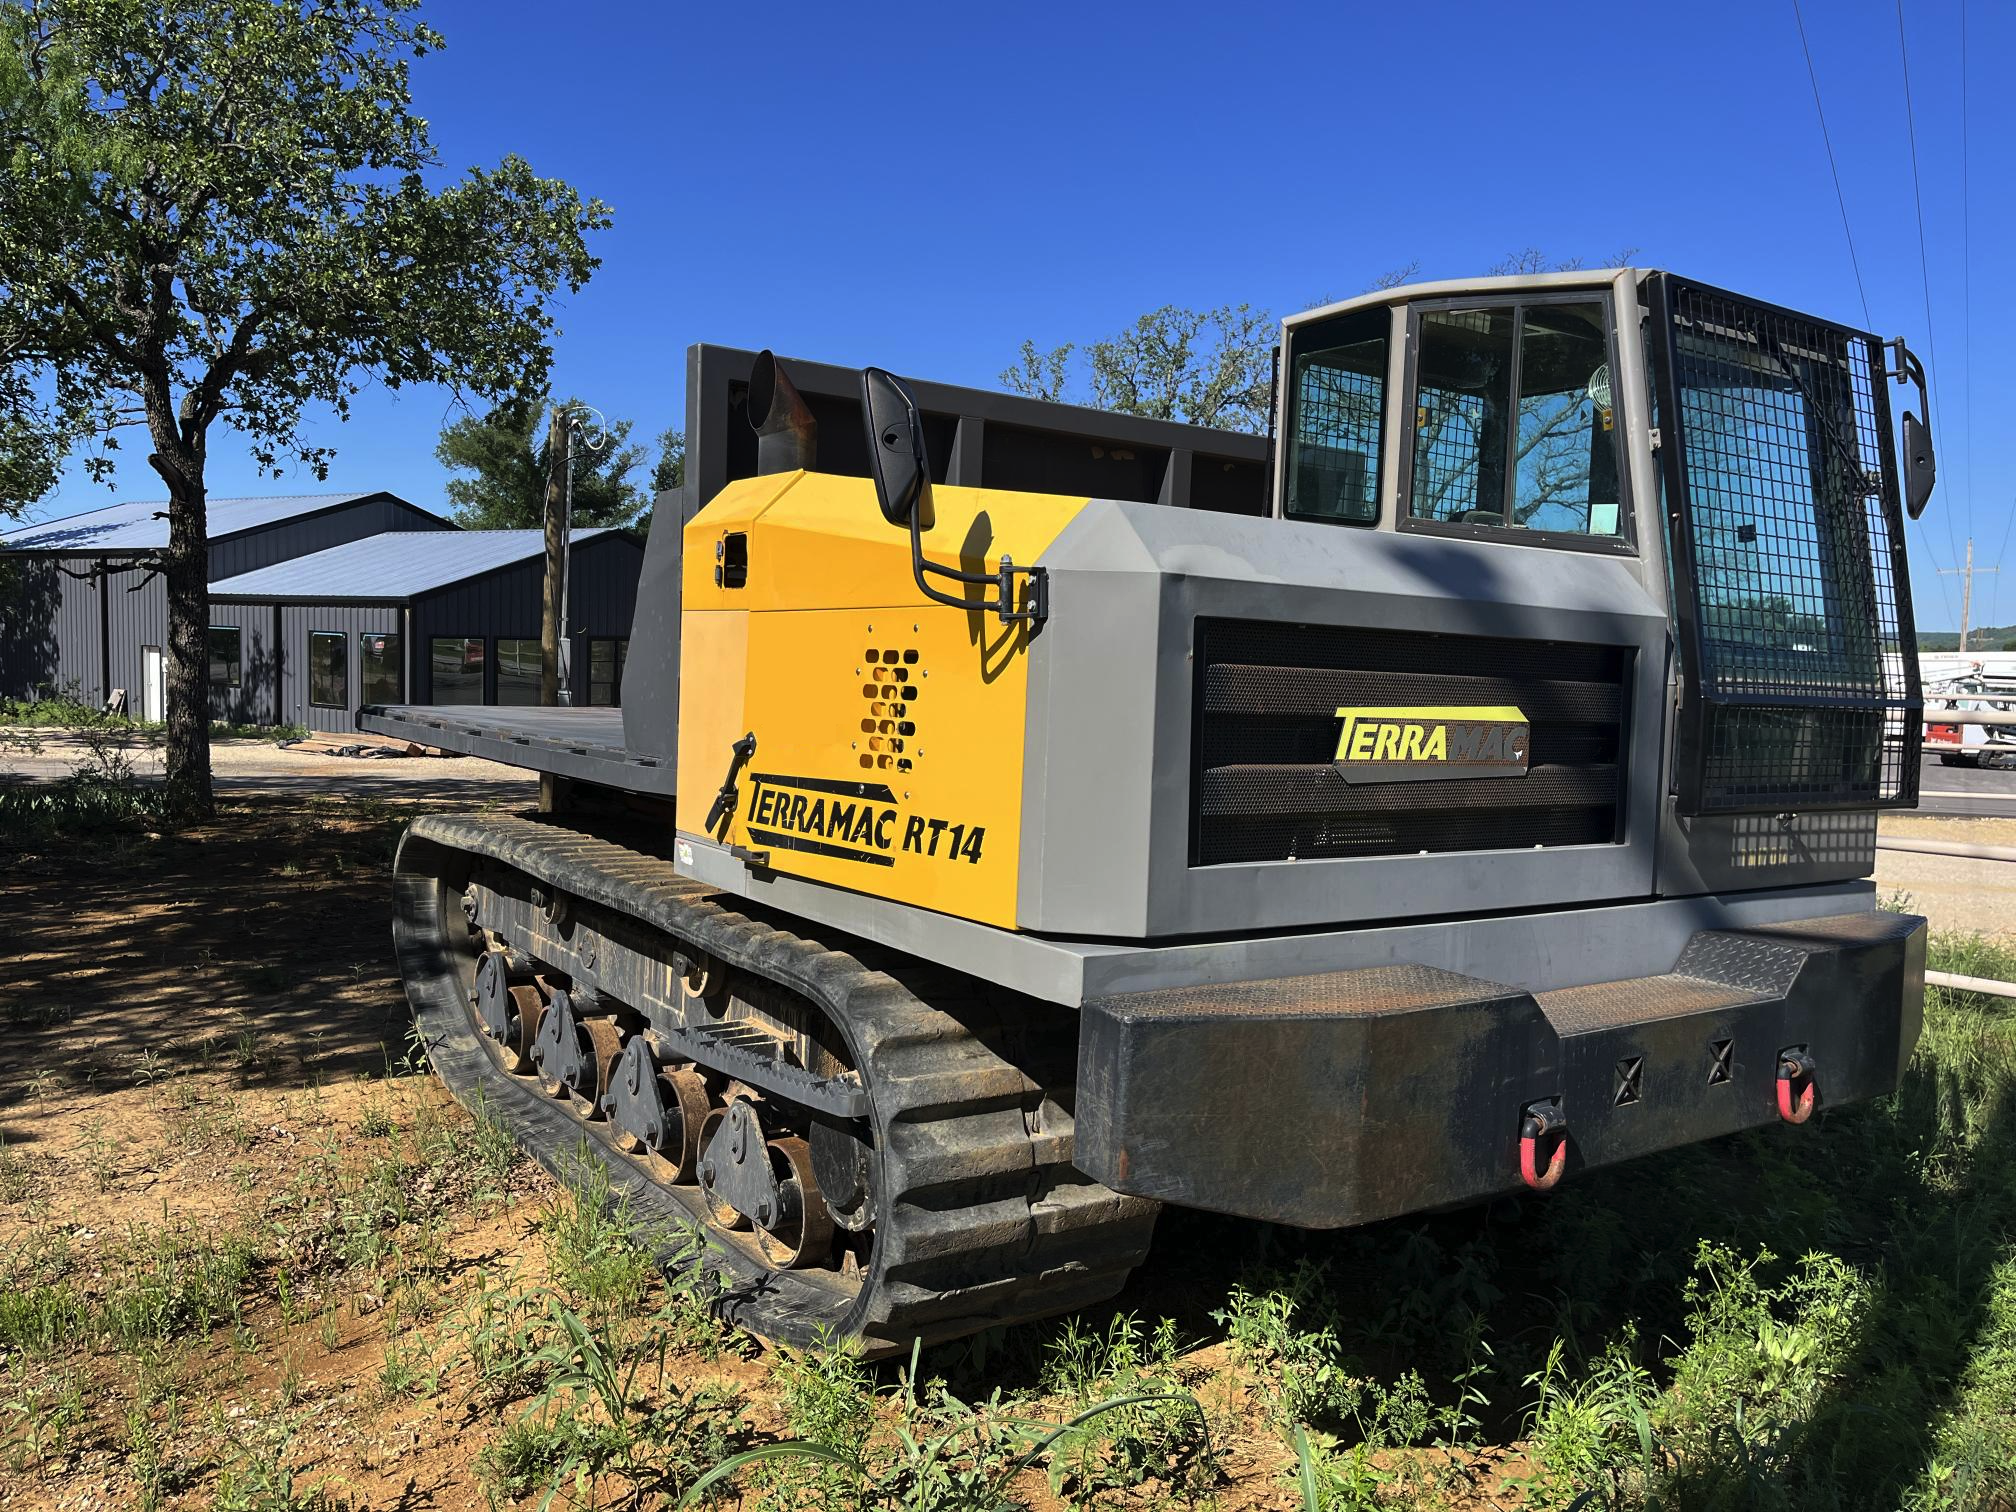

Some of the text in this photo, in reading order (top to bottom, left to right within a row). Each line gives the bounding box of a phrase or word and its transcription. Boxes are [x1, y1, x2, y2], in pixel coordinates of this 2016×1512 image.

[1335, 706, 1529, 761] TERRAMAC
[748, 773, 986, 865] TERRAMAC RT14
